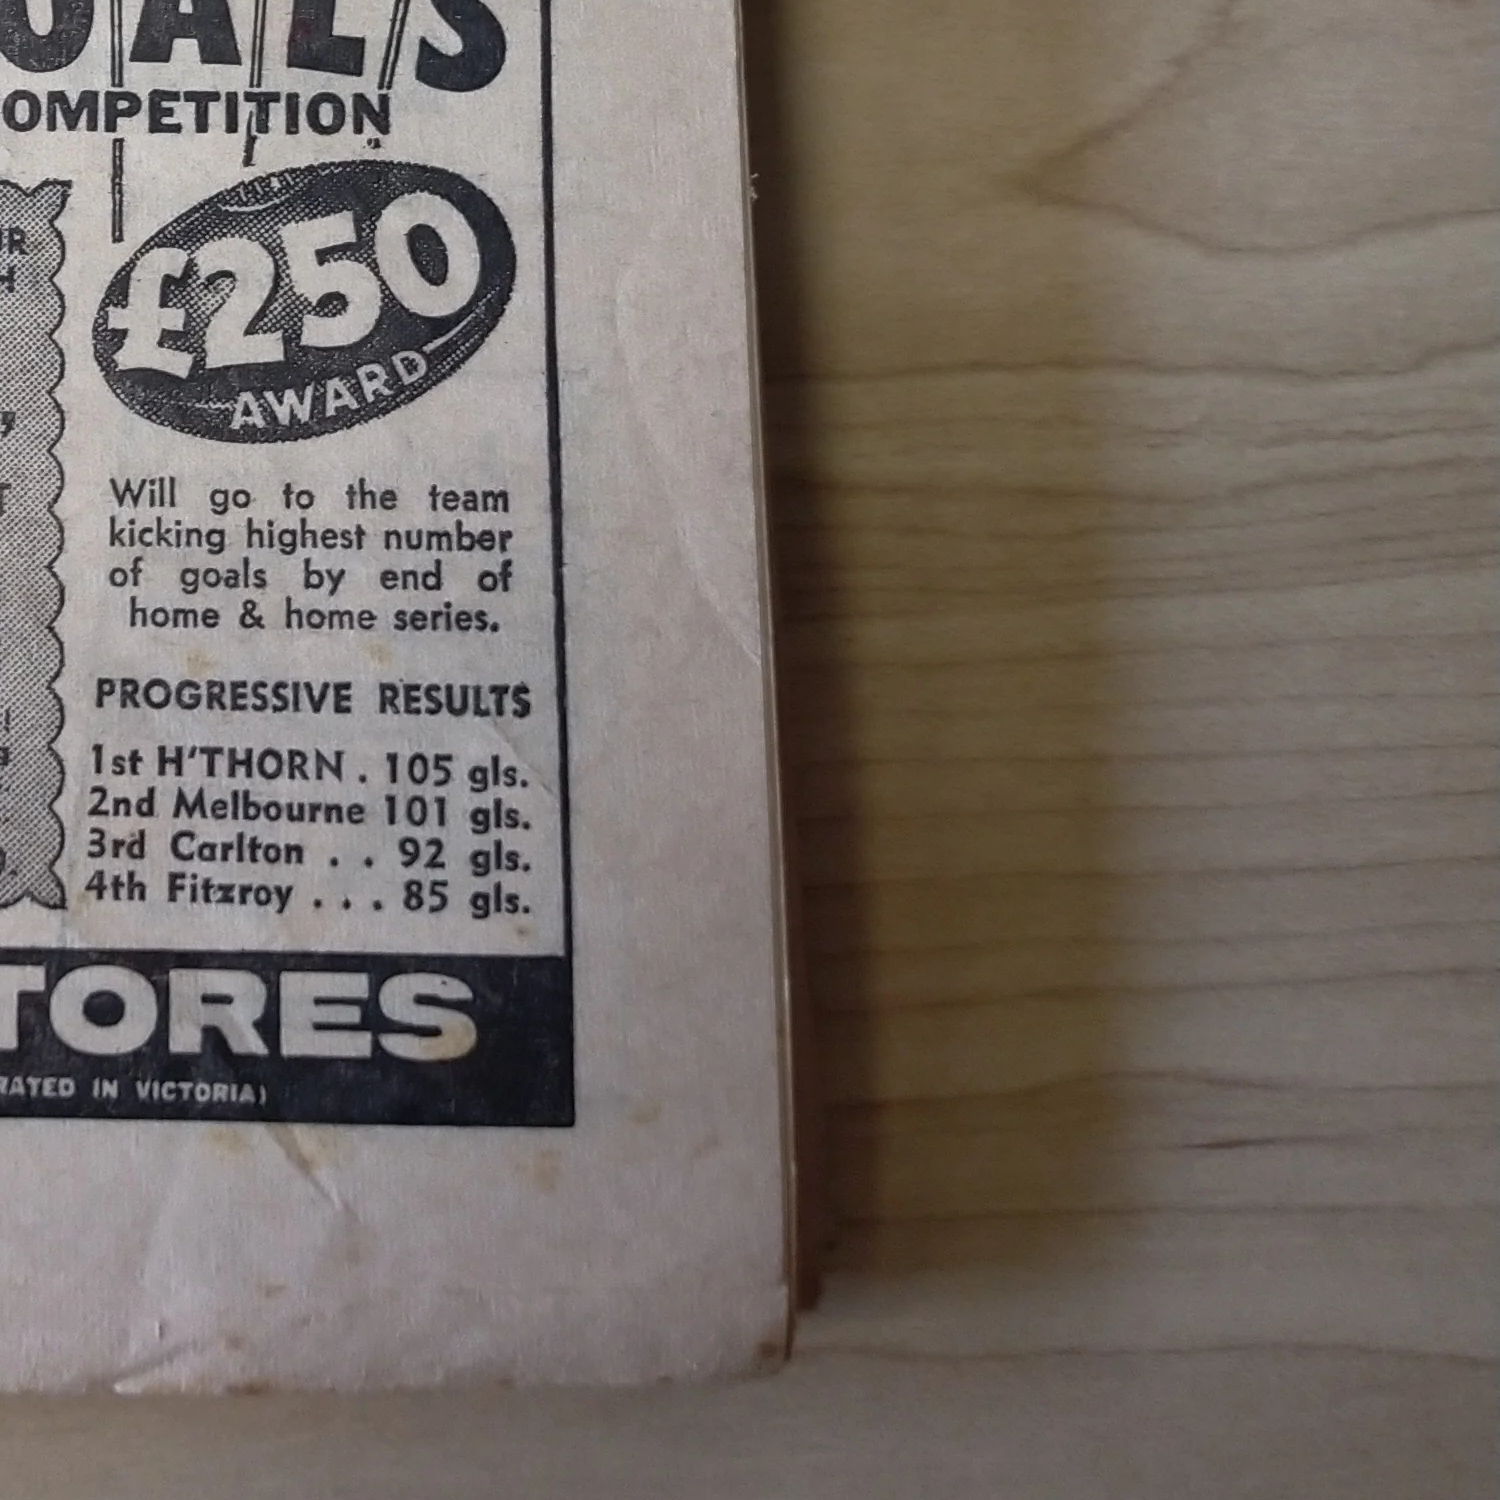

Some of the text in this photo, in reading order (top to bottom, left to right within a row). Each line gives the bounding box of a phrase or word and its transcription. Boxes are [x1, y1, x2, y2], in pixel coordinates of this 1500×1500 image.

[108, 191, 481, 378] £250
[230, 350, 430, 430] AWARD
[109, 475, 510, 516] Will go to the team
[109, 515, 514, 556] kicking highest number
[108, 555, 513, 597] of goals by end of
[129, 595, 500, 633] home & home series.
[95, 677, 531, 719] PROGRESSIVE RESULTS
[91, 743, 529, 794] 1st H'THORN 105 gls.
[87, 785, 531, 835] 2nd Melbourne 101 gls.
[87, 827, 531, 878] 3rd Carlton 92 gls.
[84, 869, 530, 920] 4th Fitzroy 85 gls.
[92, 1078, 119, 1099] IN
[135, 1079, 267, 1106] VICTORIA)
